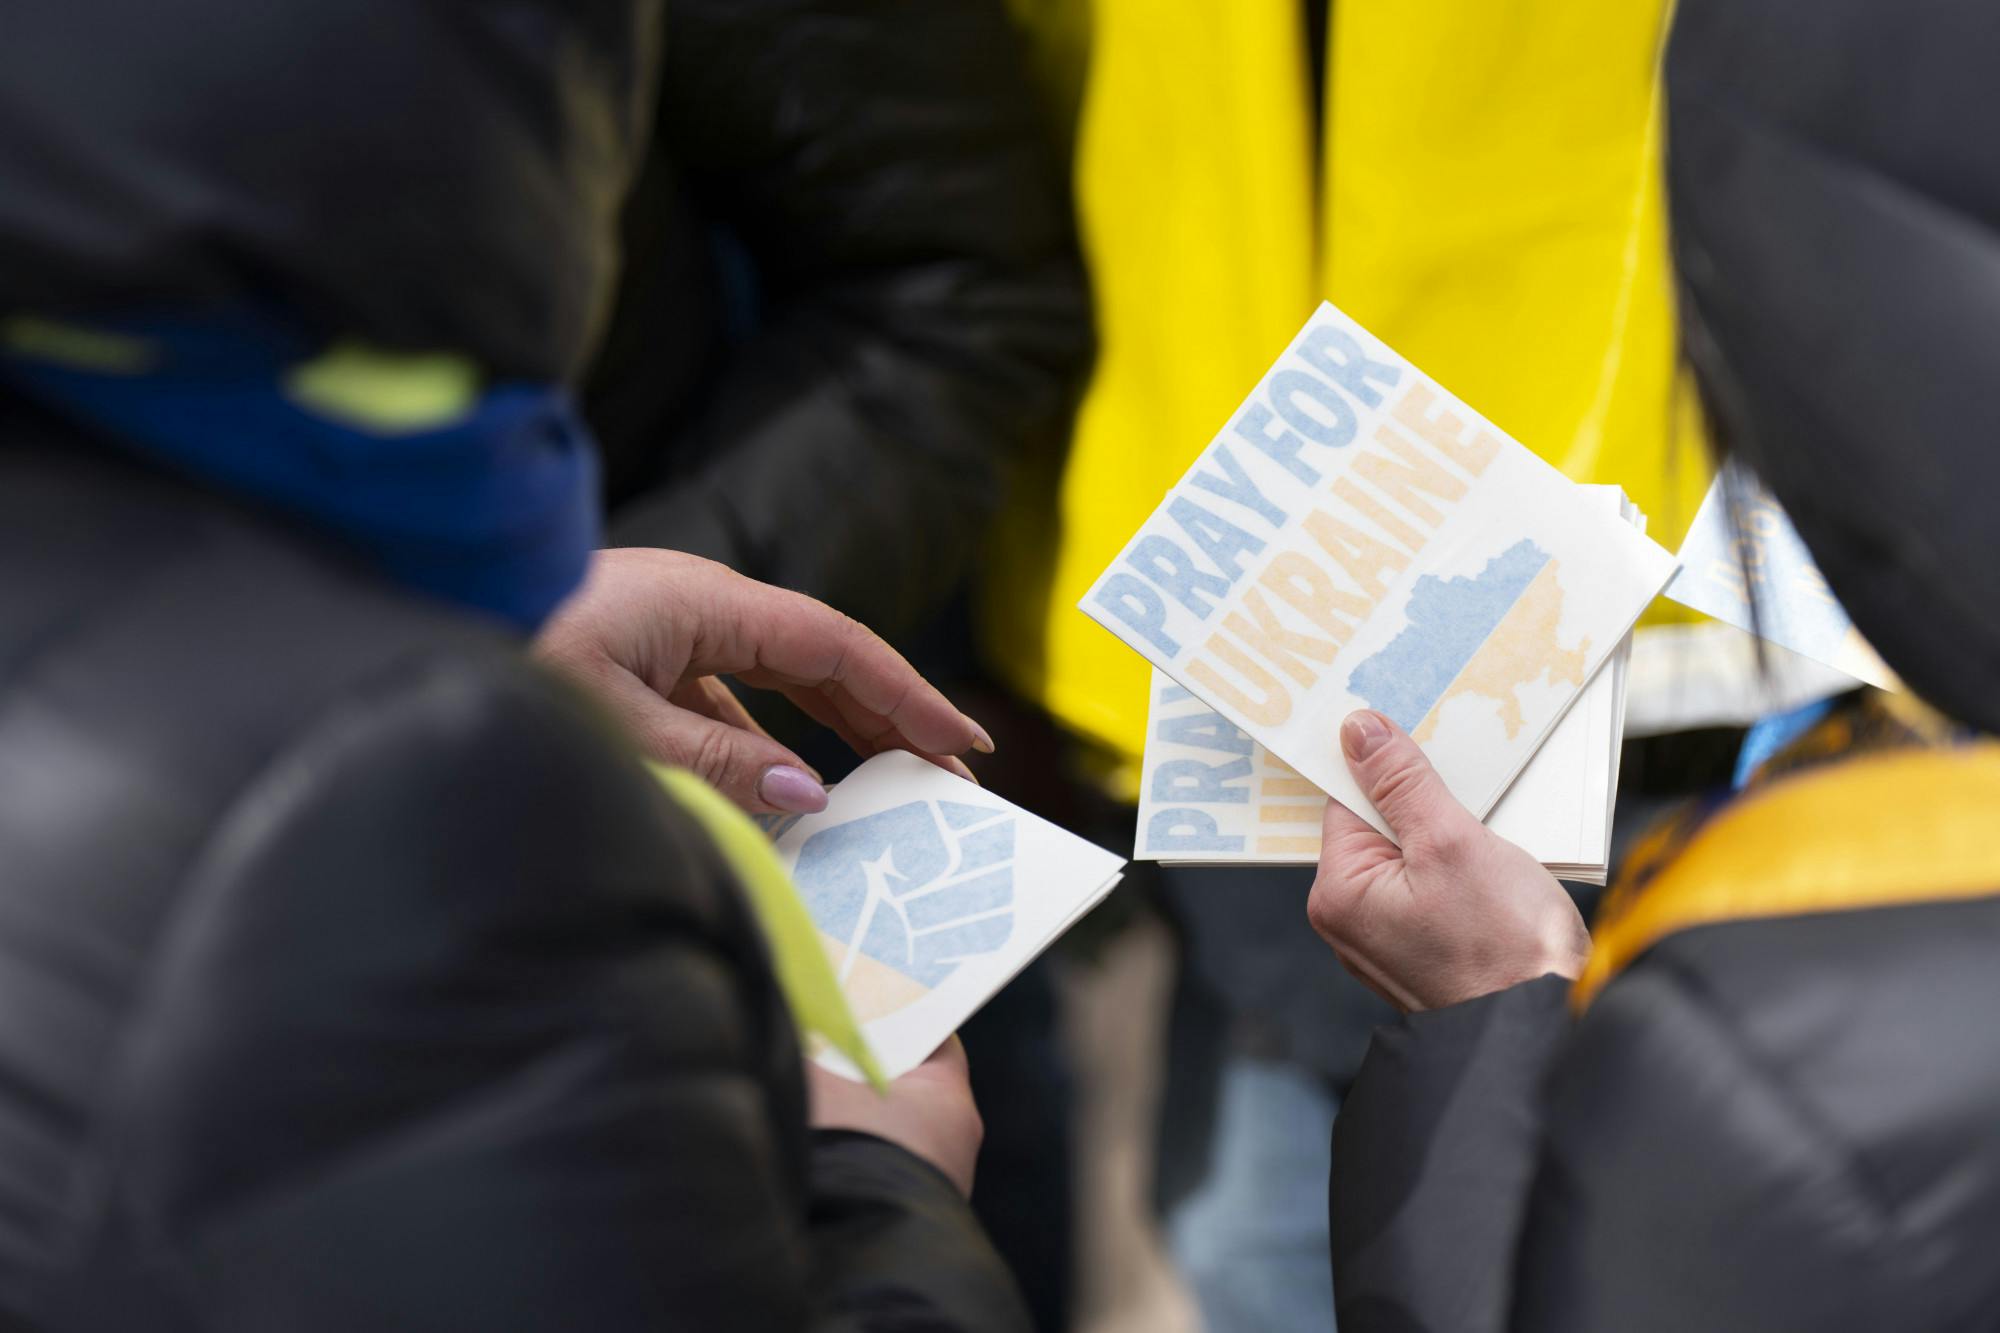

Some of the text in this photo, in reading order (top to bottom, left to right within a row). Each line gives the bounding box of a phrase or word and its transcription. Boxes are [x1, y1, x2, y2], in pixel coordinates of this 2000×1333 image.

[1094, 325, 1401, 659] PRAY FOR
[1184, 381, 1500, 727] UKRAINE
[1145, 686, 1254, 853] PRA
